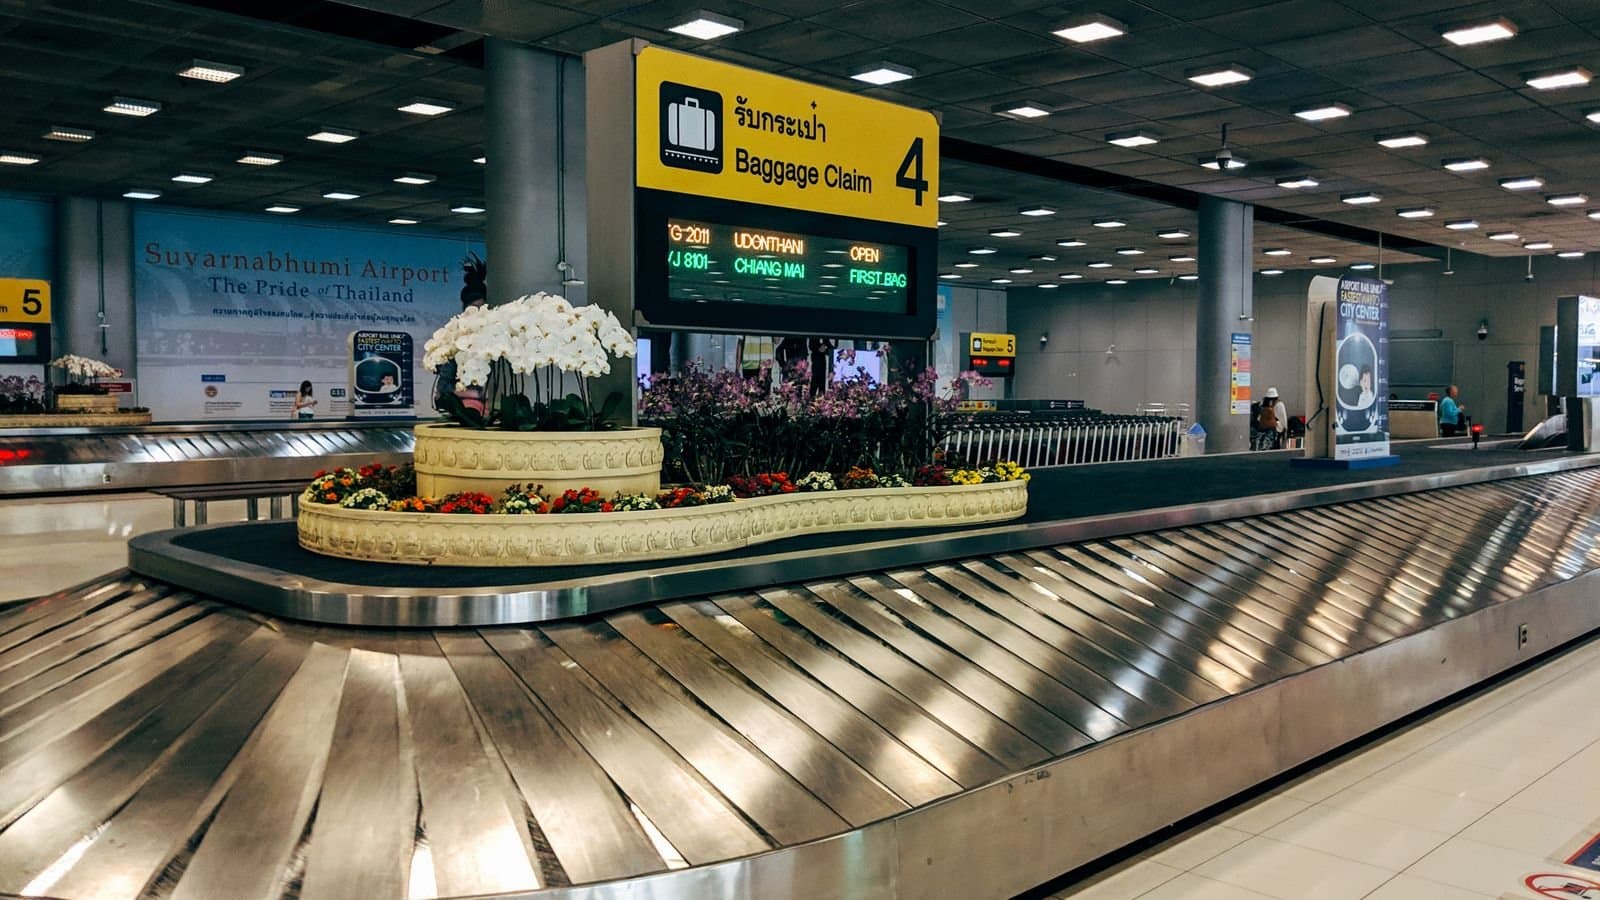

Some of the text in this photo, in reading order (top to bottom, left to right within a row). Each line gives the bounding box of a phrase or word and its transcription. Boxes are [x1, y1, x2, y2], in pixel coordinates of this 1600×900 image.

[734, 95, 827, 143] รับกระเป๋า
[735, 148, 872, 194] Baggage Claim
[895, 136, 929, 207] 4
[667, 224, 682, 242] G
[685, 225, 710, 245] 2011
[850, 246, 880, 263] OPEN
[144, 242, 450, 286] Suvarnabhumi Airport
[683, 251, 708, 270] 8101
[734, 257, 782, 276] CHIANG
[784, 262, 805, 279] MAI
[849, 269, 882, 286] FIRST
[884, 272, 908, 288] BAG
[22, 288, 42, 316] 5
[208, 276, 414, 304] The Pride of Thailand
[1340, 303, 1380, 320] CITY CENTER
[374, 344, 402, 352] CENTER
[1007, 339, 1014, 353] 5
